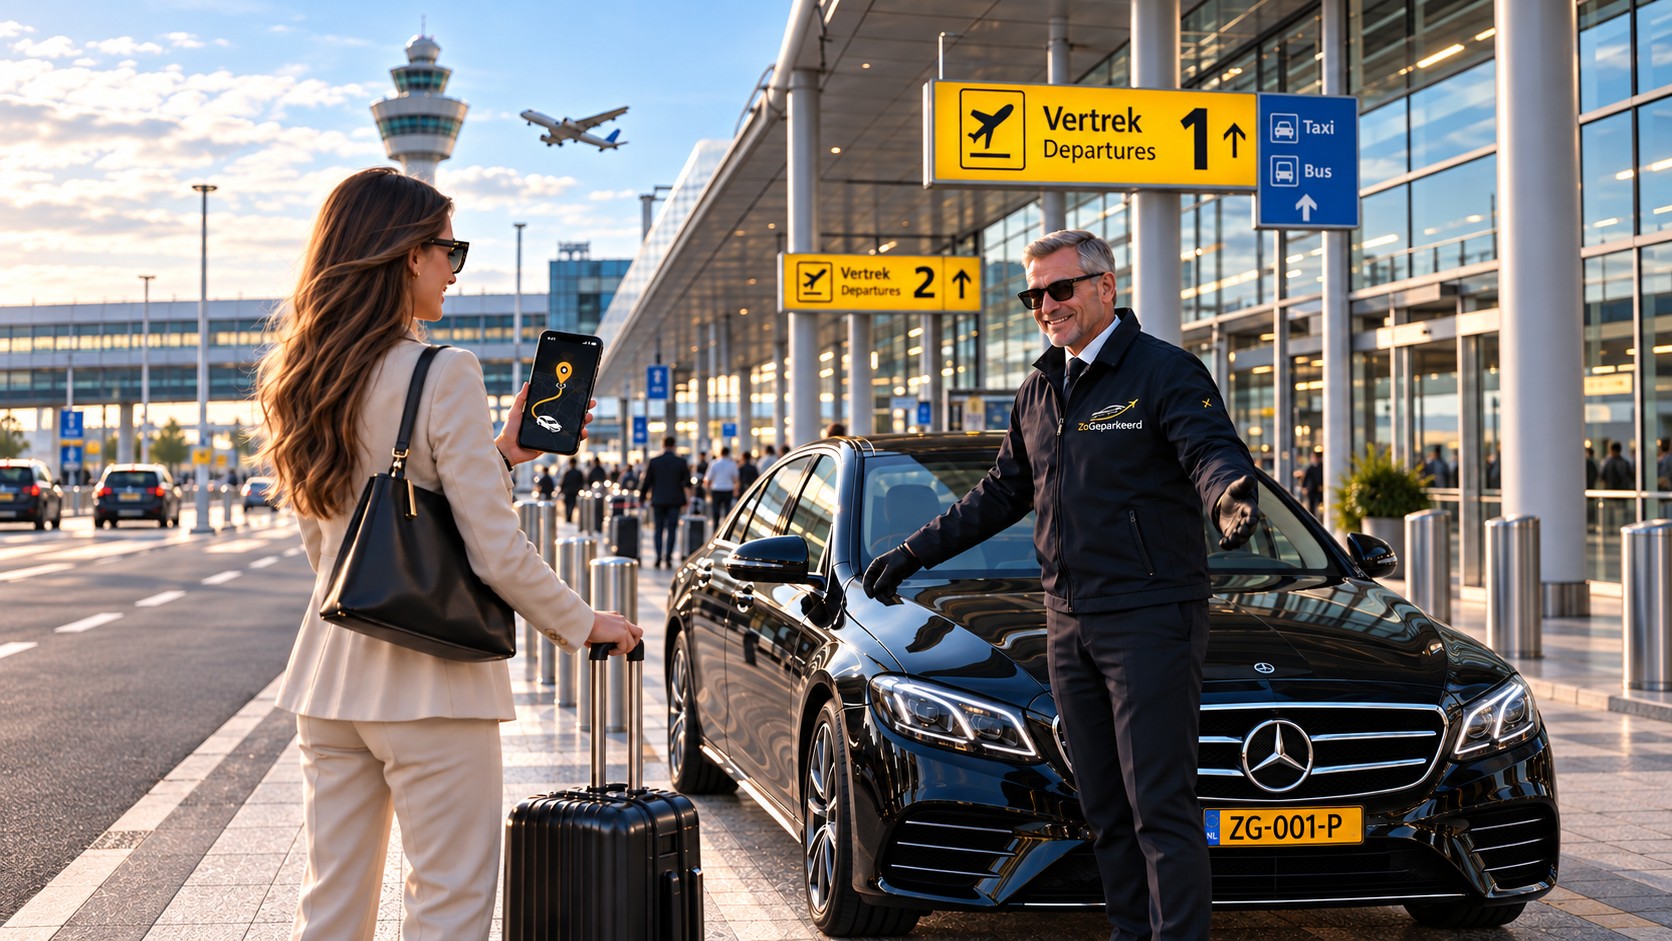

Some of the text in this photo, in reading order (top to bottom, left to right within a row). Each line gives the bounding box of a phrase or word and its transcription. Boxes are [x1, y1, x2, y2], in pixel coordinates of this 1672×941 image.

[1043, 106, 1142, 133] Vertrek
[1303, 120, 1334, 135] Taxi
[1180, 107, 1208, 170] 1
[1043, 139, 1156, 163] Departures
[1304, 164, 1332, 178] Bus
[841, 267, 890, 280] Vertrek
[913, 266, 935, 298] 2
[841, 285, 900, 298] Departures
[1078, 420, 1143, 432] ZoGeparkeerd
[1229, 813, 1342, 841] ZG-001-P
[1207, 832, 1218, 840] NL
